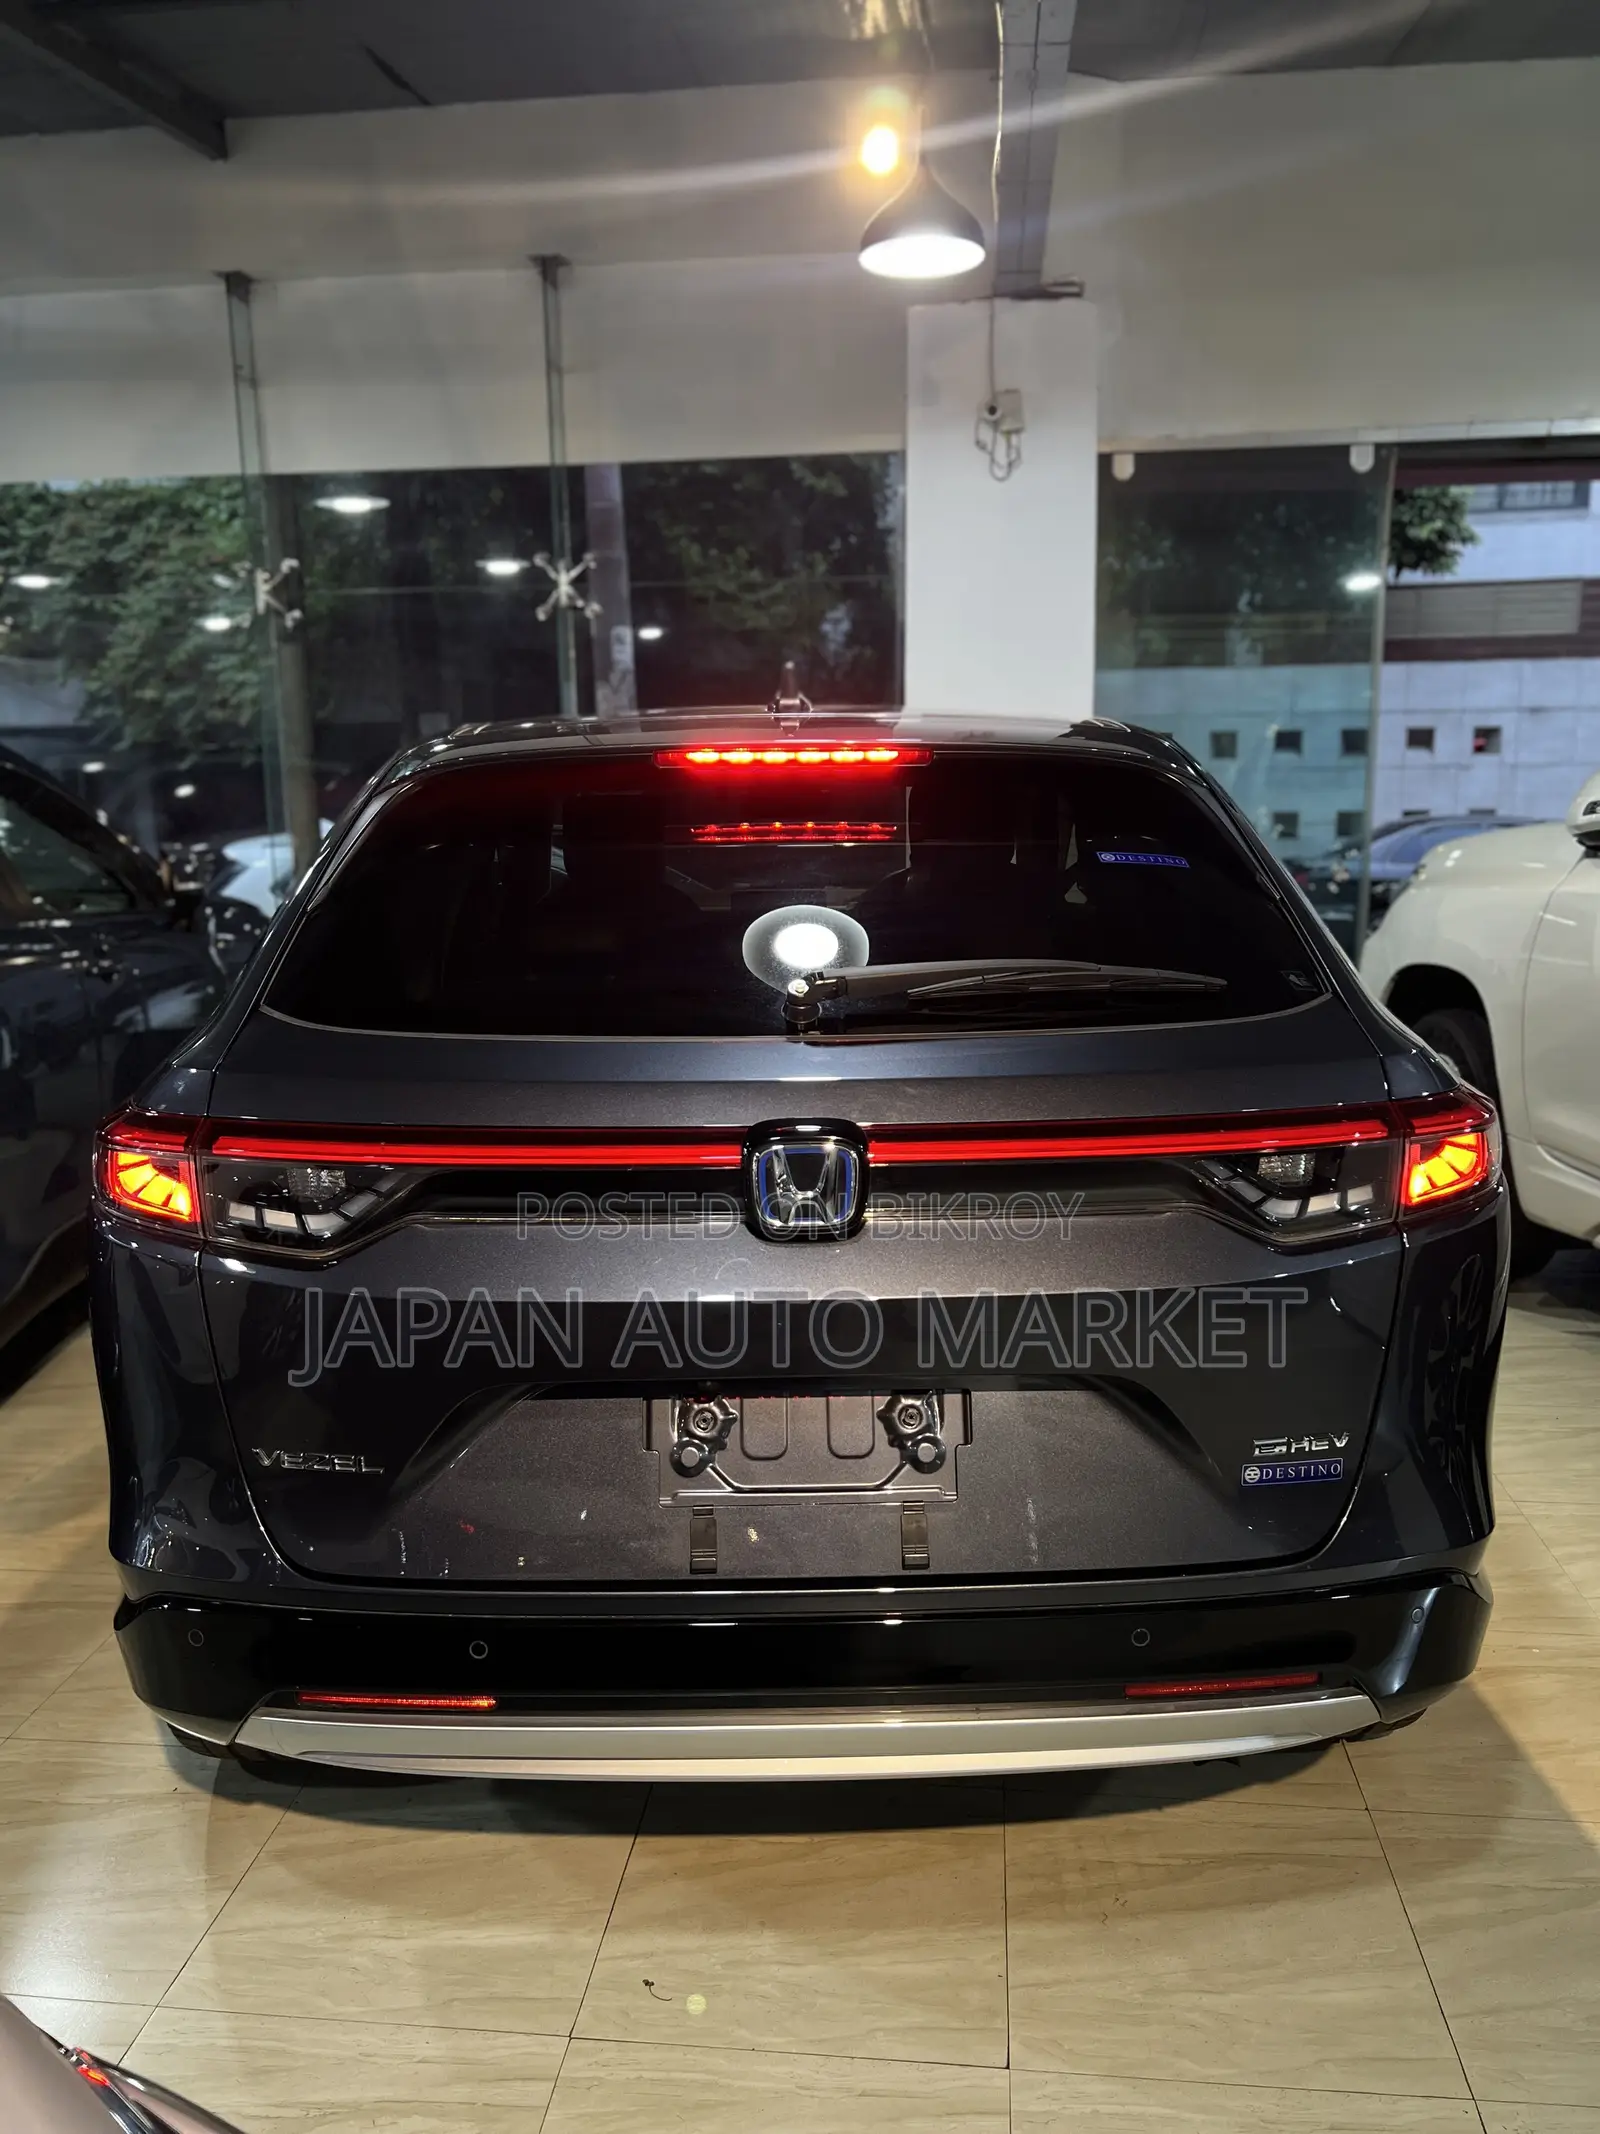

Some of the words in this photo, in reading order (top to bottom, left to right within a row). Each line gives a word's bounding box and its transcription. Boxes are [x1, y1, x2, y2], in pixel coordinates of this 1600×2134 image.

[1115, 854, 1186, 865] DESTINO
[251, 1447, 385, 1475] VEZEL
[1262, 1463, 1341, 1480] DESTINO
